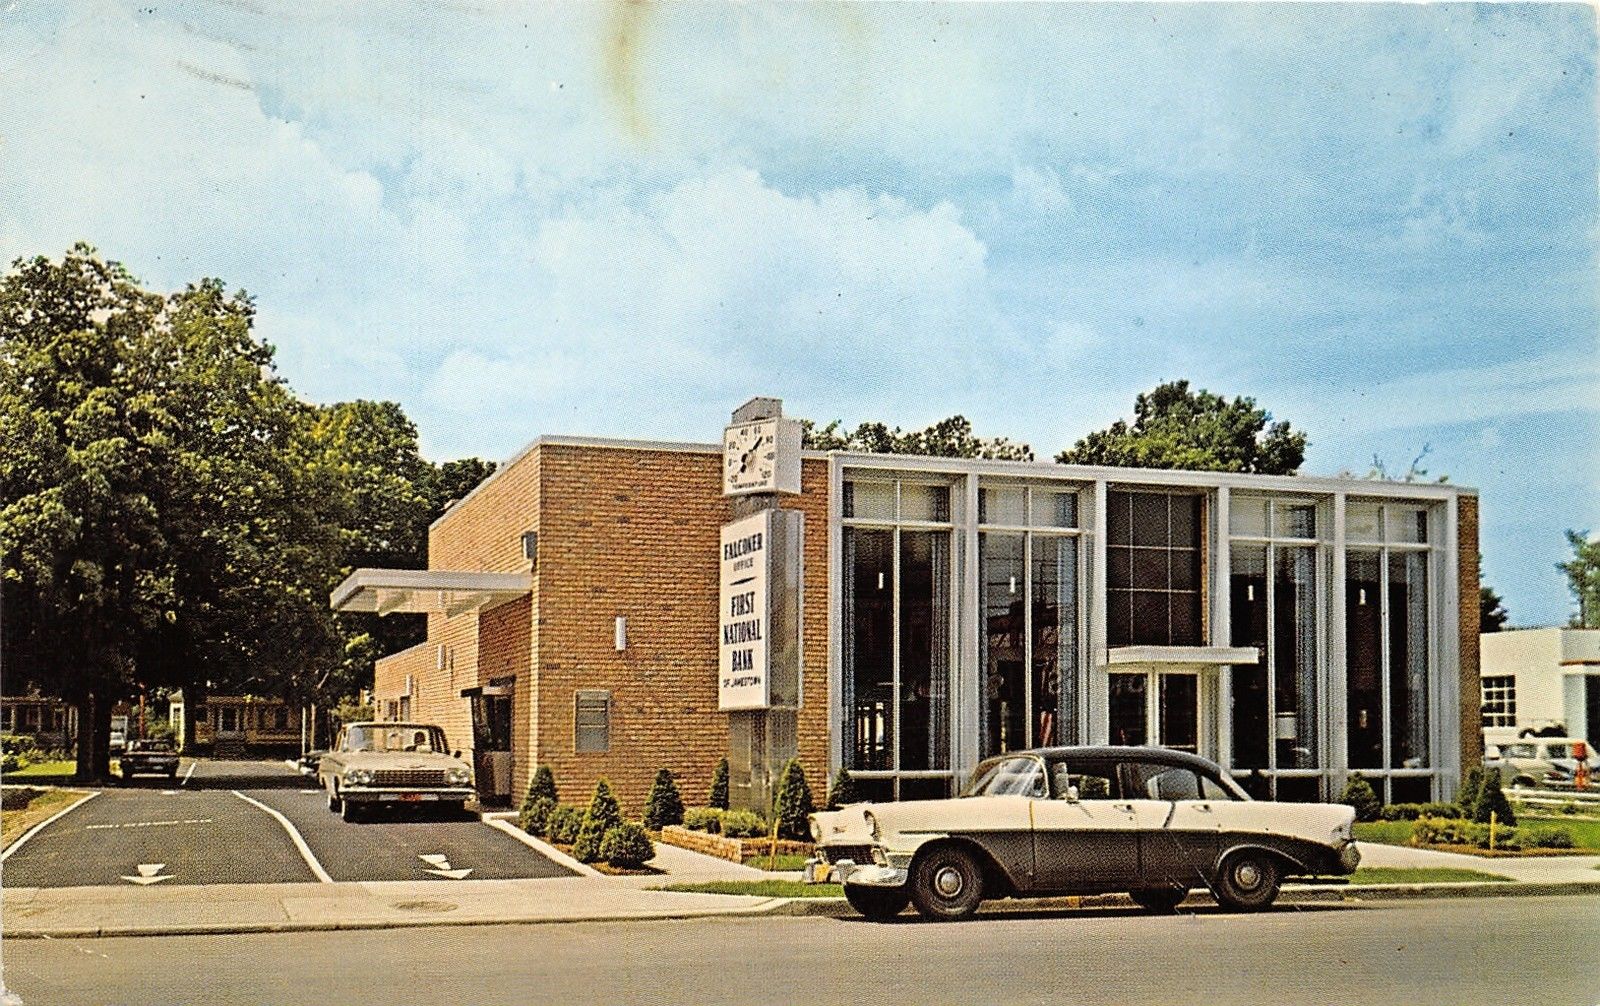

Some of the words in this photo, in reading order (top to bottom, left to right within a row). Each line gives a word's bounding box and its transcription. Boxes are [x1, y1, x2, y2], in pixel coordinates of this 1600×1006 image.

[724, 533, 762, 560] FALCONER
[733, 557, 754, 572] OFFICE
[731, 591, 755, 617] FIRST
[724, 619, 762, 645] NATIONAL
[732, 649, 753, 672] BANK
[723, 678, 731, 688] OF
[731, 676, 761, 688] JAMESTOWN
